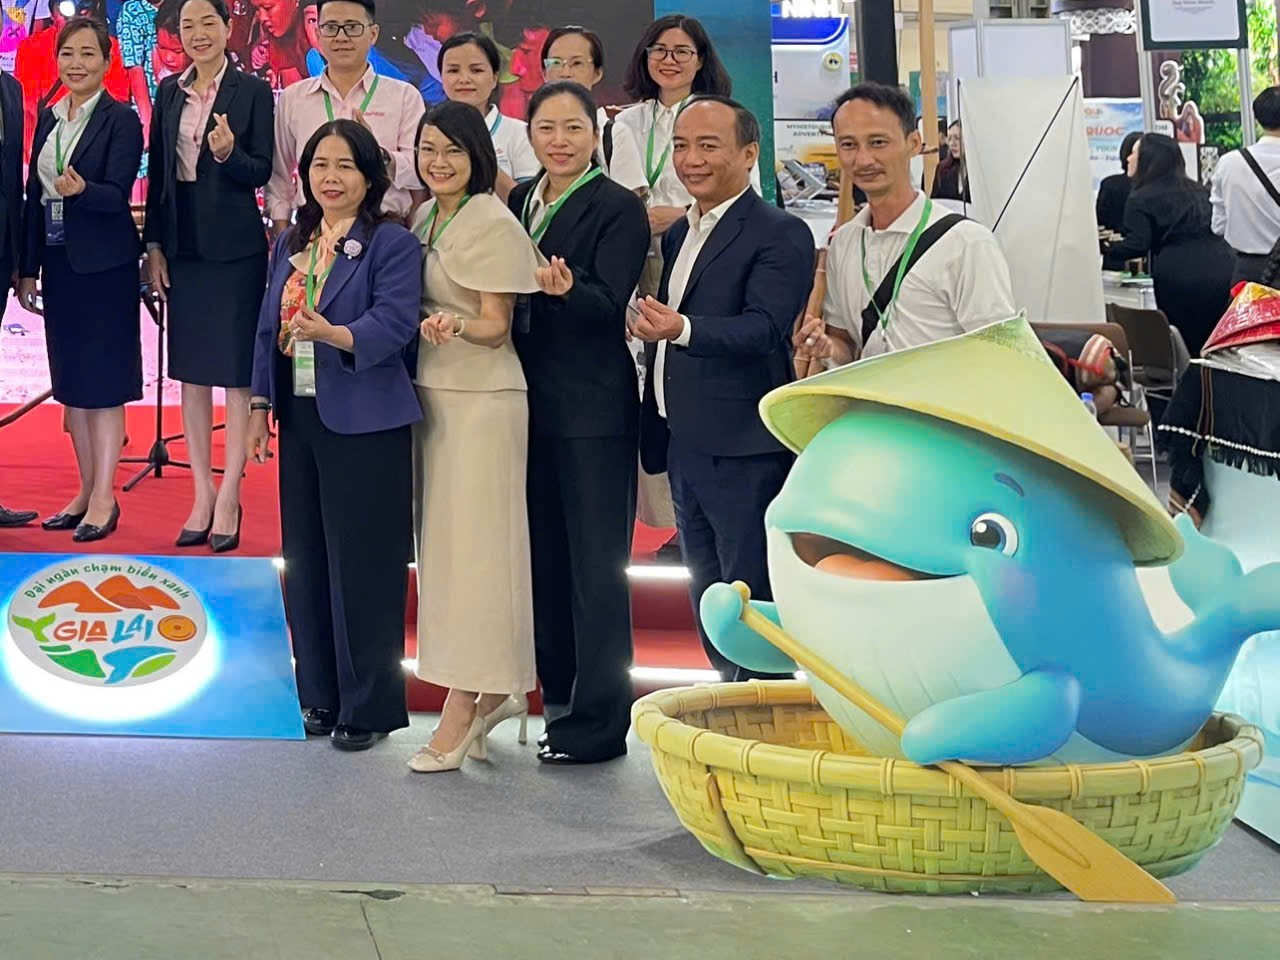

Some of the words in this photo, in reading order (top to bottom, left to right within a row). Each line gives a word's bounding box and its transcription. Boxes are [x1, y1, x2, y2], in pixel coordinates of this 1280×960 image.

[25, 581, 46, 599] Đại
[47, 568, 79, 584] ngàn
[84, 563, 122, 575] chạm
[160, 578, 190, 600] xanh
[53, 620, 108, 642] GIA
[111, 613, 154, 644] LAI
